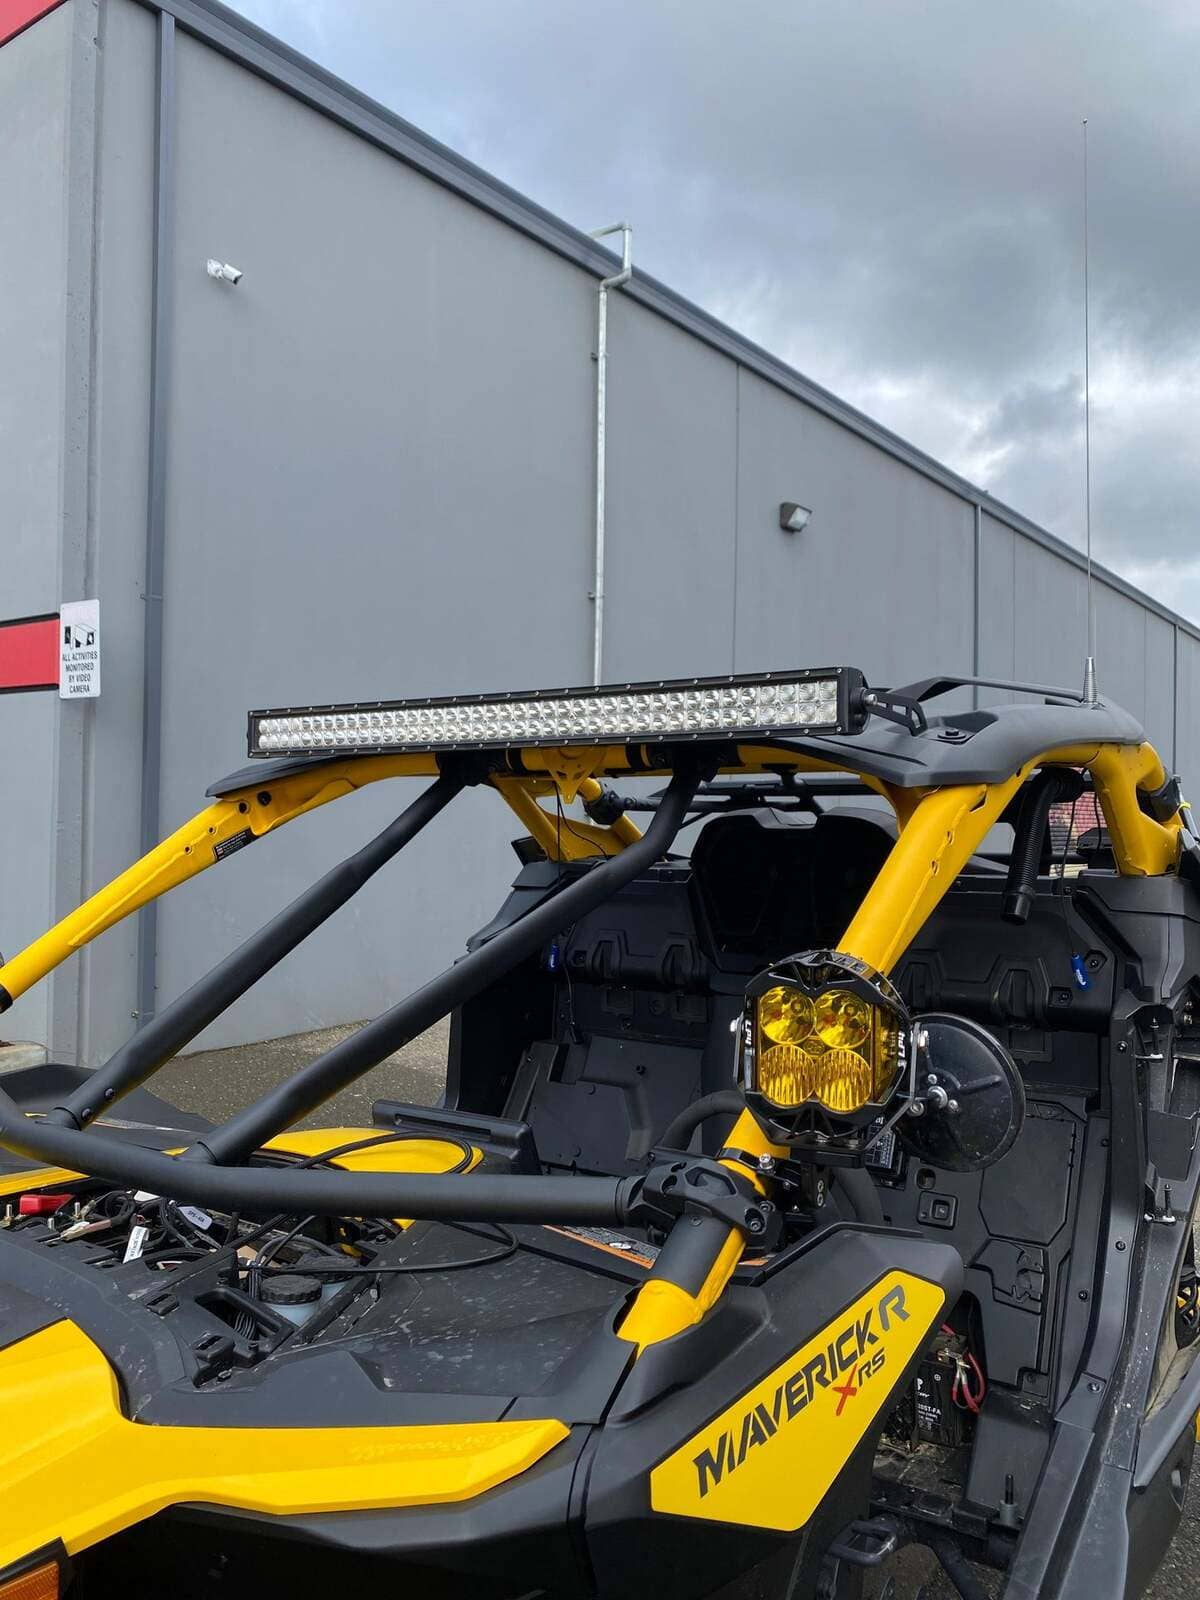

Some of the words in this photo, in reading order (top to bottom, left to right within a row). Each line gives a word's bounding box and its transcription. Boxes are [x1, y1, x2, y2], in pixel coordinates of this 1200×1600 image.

[62, 653, 71, 662] ALL
[72, 650, 98, 661] ACTIVITIES
[65, 662, 95, 672] MONITORED
[68, 674, 75, 683] BY
[76, 673, 91, 682] VIDEO
[69, 685, 90, 693] CAMERA
[692, 1307, 879, 1498] MAVERICK
[878, 1284, 911, 1332] R
